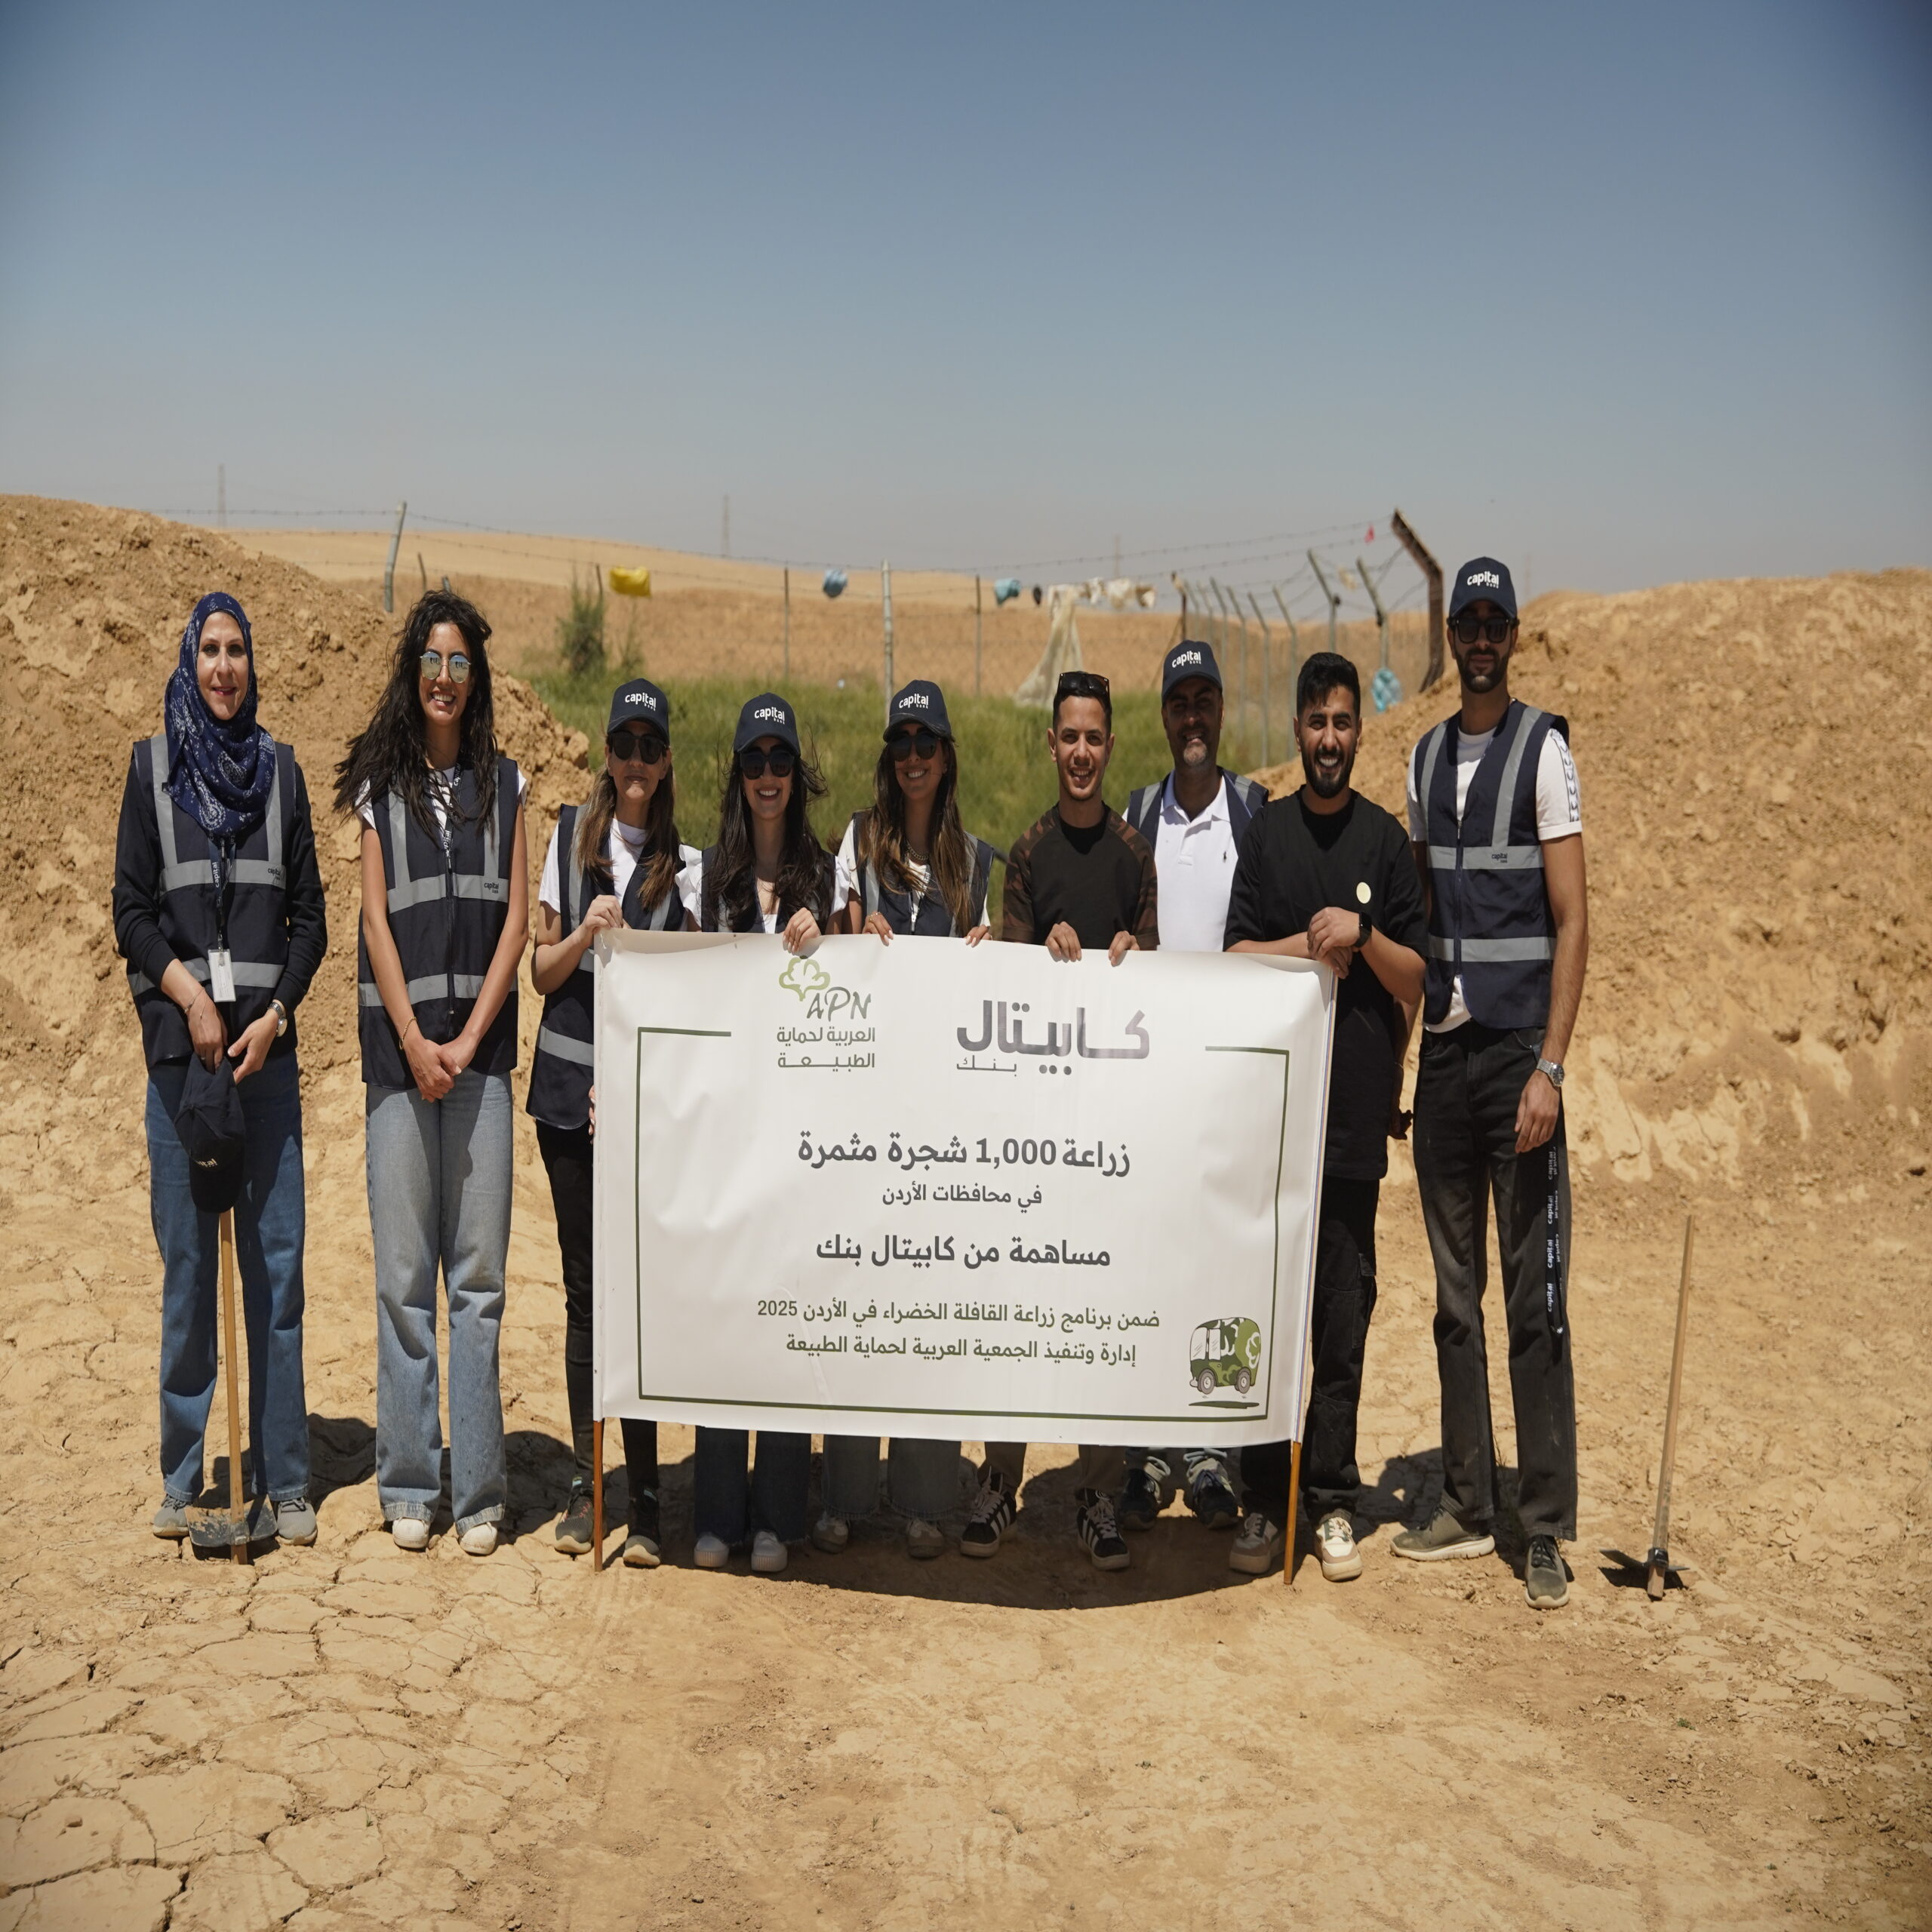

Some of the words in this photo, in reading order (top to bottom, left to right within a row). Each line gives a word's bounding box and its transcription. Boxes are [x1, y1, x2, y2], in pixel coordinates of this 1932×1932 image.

[1467, 571, 1499, 586] capital
[1172, 651, 1201, 668] capital
[625, 692, 656, 708] capital
[899, 694, 928, 708] capital
[755, 706, 785, 721] capital
[807, 986, 871, 1022] APN
[777, 1027, 823, 1047] لحماية
[827, 1026, 875, 1046] العربية
[957, 1000, 1149, 1075] كابيتال
[778, 1053, 875, 1072] الطبيعة
[957, 1055, 1017, 1077] بنك
[798, 1131, 876, 1169] مثمرة
[888, 1132, 967, 1171] شجرة
[977, 1138, 1056, 1169] 1,000
[1063, 1138, 1130, 1177] زراعة
[883, 1180, 926, 1205] الأردن
[933, 1183, 1011, 1203] محافظات
[1018, 1185, 1041, 1214] في
[817, 1234, 861, 1267] بنك
[872, 1235, 955, 1268] كابيتال
[964, 1244, 999, 1269] من
[1010, 1236, 1110, 1266] مساهمة
[758, 1300, 797, 1316] 2025
[804, 1297, 846, 1321] الأردن
[853, 1299, 877, 1327] في
[883, 1300, 947, 1322] الخضراء
[954, 1301, 1007, 1321] القافلة
[1014, 1304, 1054, 1327] زراعة
[1061, 1307, 1111, 1333] برنامج
[1118, 1310, 1159, 1331] ضمن
[786, 1334, 847, 1357] الطبيعة
[854, 1336, 906, 1358] لحماية
[912, 1337, 967, 1360] العربية
[974, 1339, 1037, 1362] الجمعية
[1044, 1342, 1094, 1364] وتنفيذ
[1101, 1343, 1135, 1367] إدارة
